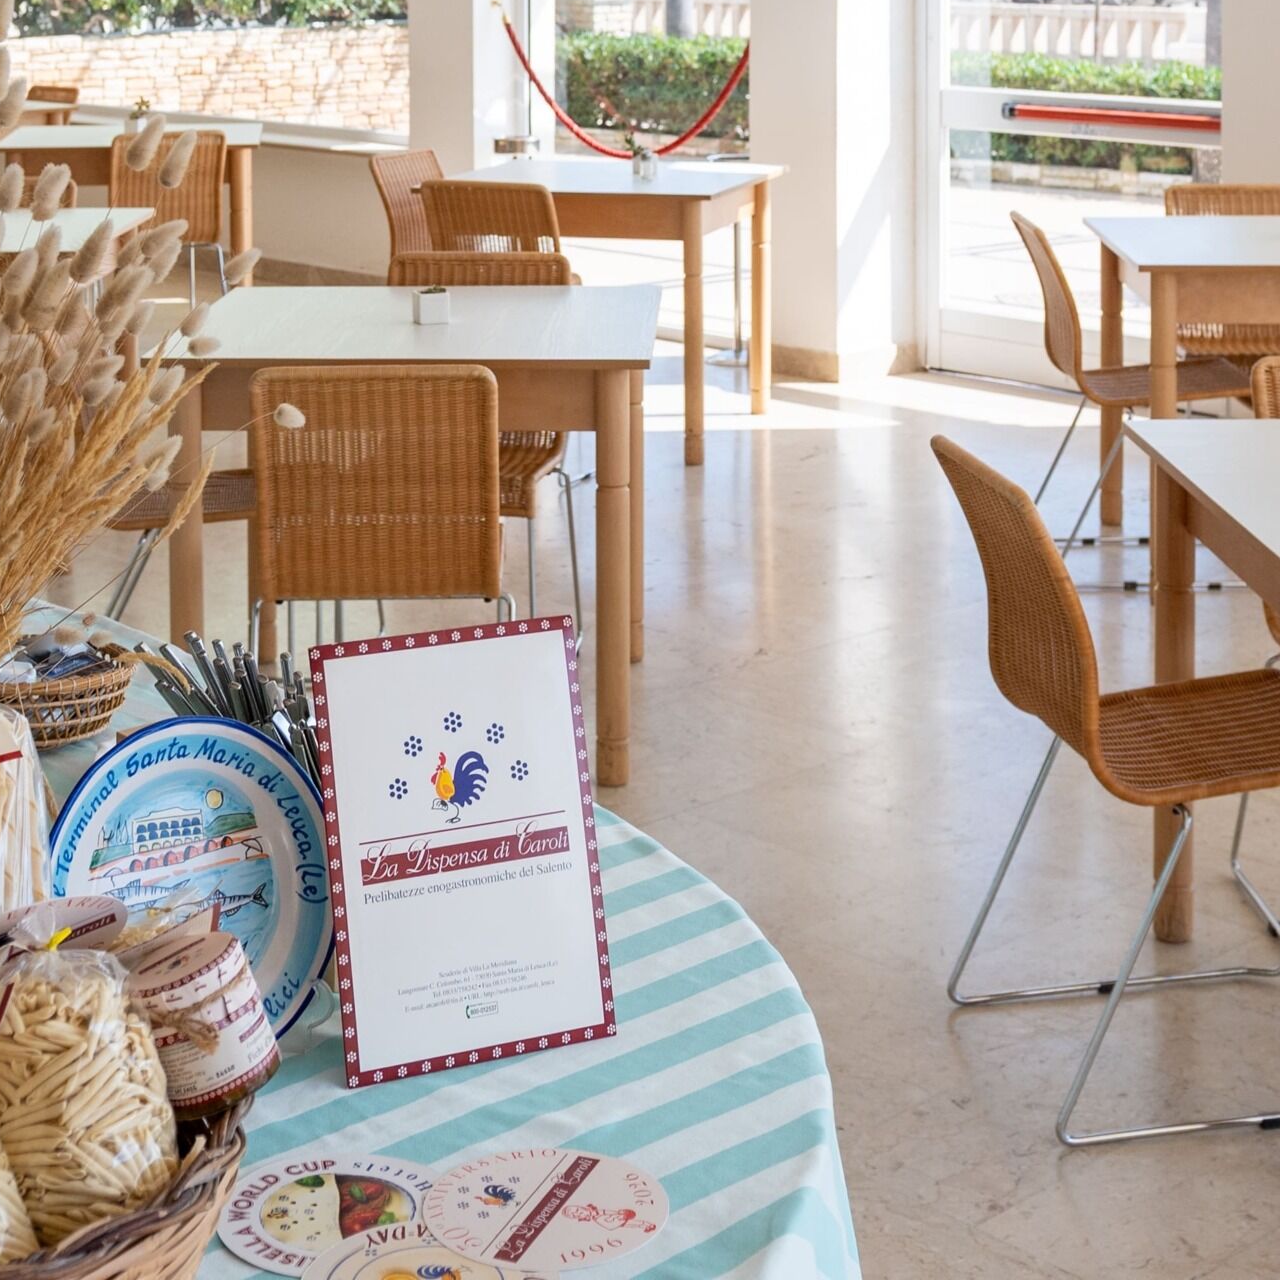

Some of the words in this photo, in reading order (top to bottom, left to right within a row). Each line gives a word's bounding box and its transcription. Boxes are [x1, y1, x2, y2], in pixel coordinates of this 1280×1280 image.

[56, 770, 119, 877] Terminal
[126, 737, 191, 778] Santa
[193, 738, 255, 778] Maria
[258, 772, 284, 793] di
[277, 795, 312, 860] Leuca
[363, 842, 399, 882] La
[407, 839, 488, 874] Dispensa
[493, 840, 510, 858] di
[516, 820, 568, 854] Caroli
[364, 886, 425, 904] Prelibatezze
[427, 870, 517, 894] enogastronomiche
[519, 865, 534, 878] del
[536, 860, 572, 876] Salento
[284, 1159, 337, 1176] CUP
[352, 1161, 433, 1192] Hotels
[228, 1174, 280, 1223] WORLD
[509, 1193, 562, 1240] Dispensa
[234, 1224, 316, 1268] ISELLA
[367, 1224, 406, 1249] DAY
[559, 1238, 624, 1264] 1996
